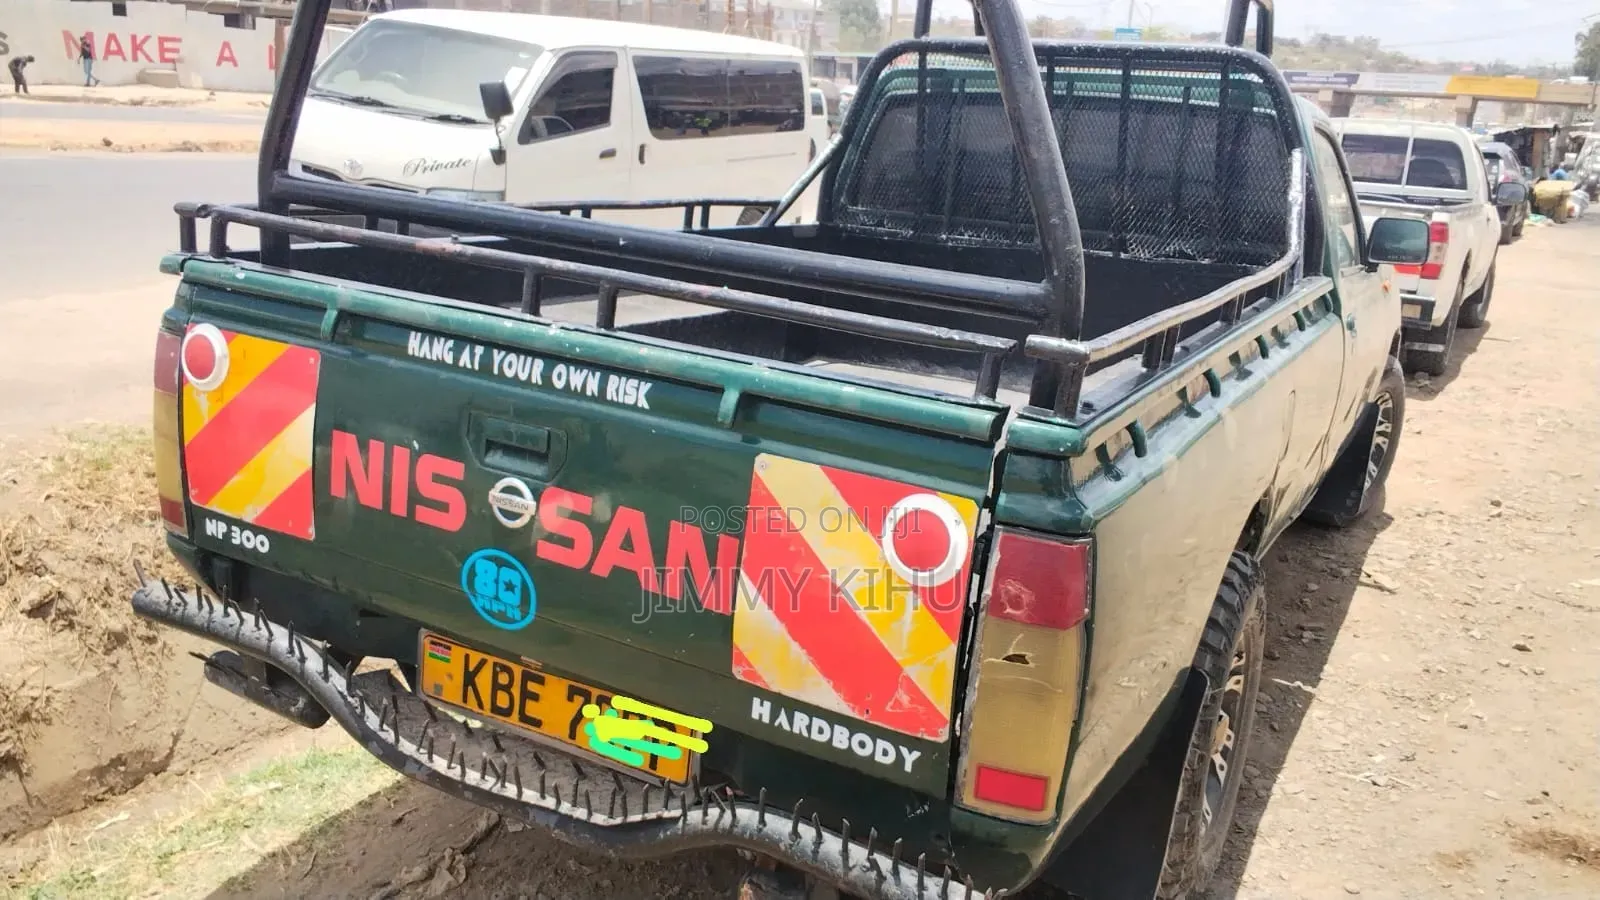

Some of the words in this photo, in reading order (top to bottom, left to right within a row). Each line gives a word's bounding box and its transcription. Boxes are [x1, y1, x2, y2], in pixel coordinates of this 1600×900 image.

[62, 29, 183, 65] MAKE
[216, 40, 239, 67] A
[402, 157, 473, 177] Private
[407, 331, 453, 363] HANG
[459, 344, 484, 371] AT
[491, 350, 543, 385] YOUR
[551, 368, 601, 396] OWN
[606, 375, 652, 410] RISK
[330, 430, 467, 532] NIS
[537, 486, 740, 616] SAN
[492, 494, 529, 511] NISSAN
[205, 517, 228, 540] NP
[231, 526, 270, 554] 300
[474, 558, 522, 606] 80
[462, 653, 546, 728] KBE
[751, 697, 921, 773] HARDBODY
